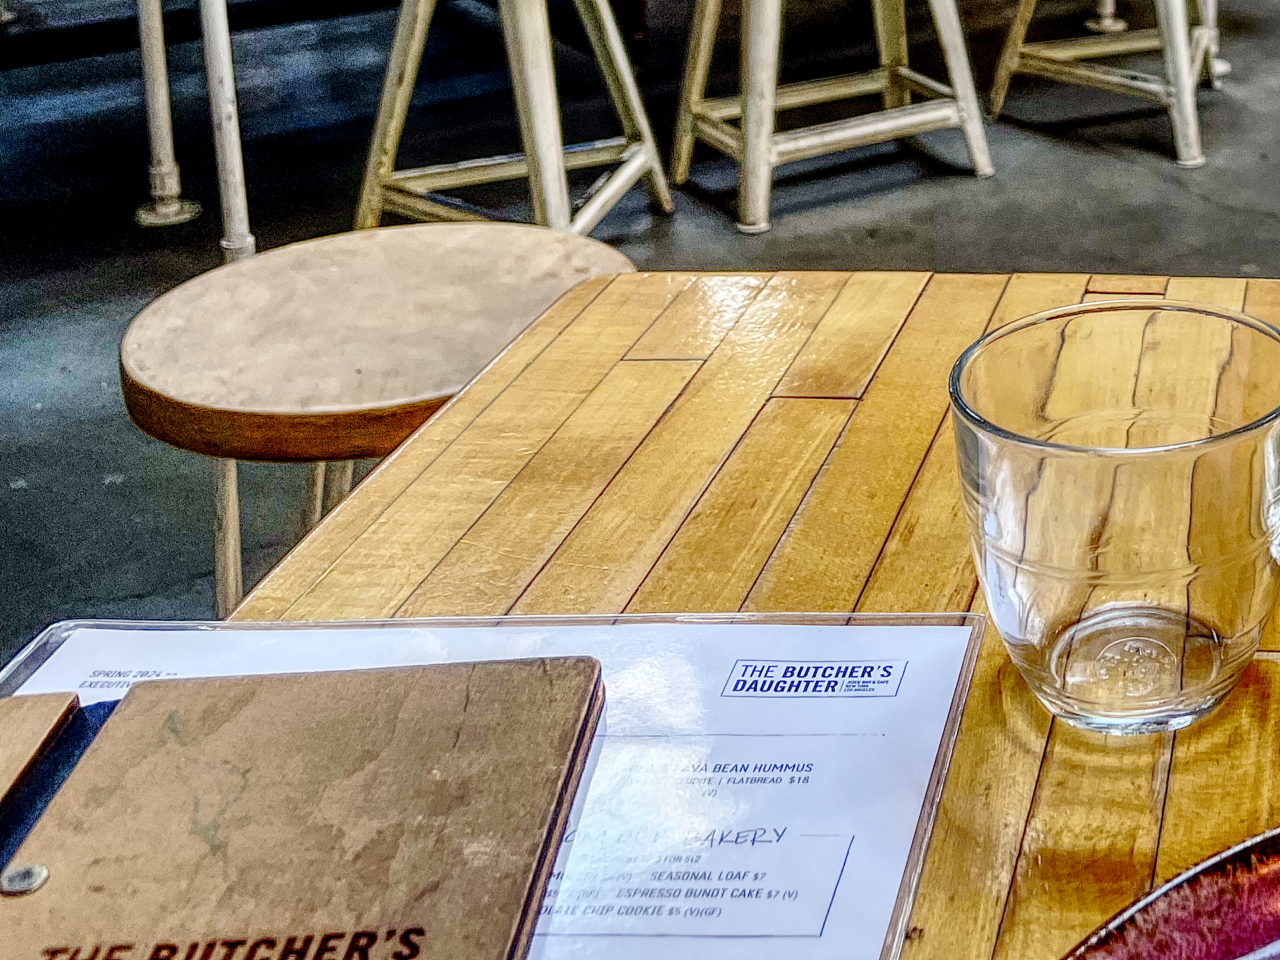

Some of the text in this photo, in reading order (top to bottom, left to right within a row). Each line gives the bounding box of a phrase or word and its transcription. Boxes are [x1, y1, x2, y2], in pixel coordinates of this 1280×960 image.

[89, 670, 162, 678] SPRING 2024
[741, 665, 894, 679] THE BUTCHER'S
[79, 680, 132, 689] EXECUTIV
[732, 679, 839, 693] DAUGHTER
[712, 763, 750, 773] BEAN
[752, 763, 814, 773] HUMMUS
[726, 776, 783, 785] FLATBREAD
[788, 776, 810, 784] $18
[649, 871, 713, 881] SEASONAL
[717, 871, 751, 881] LOAF
[616, 888, 682, 899] ESPRESSO
[730, 888, 764, 899] CAKE
[766, 890, 780, 900] $7
[782, 890, 798, 901] (V)
[582, 905, 615, 915] CHIP
[617, 905, 664, 916] COOKIE
[148, 927, 426, 960] BUTCHER'S
